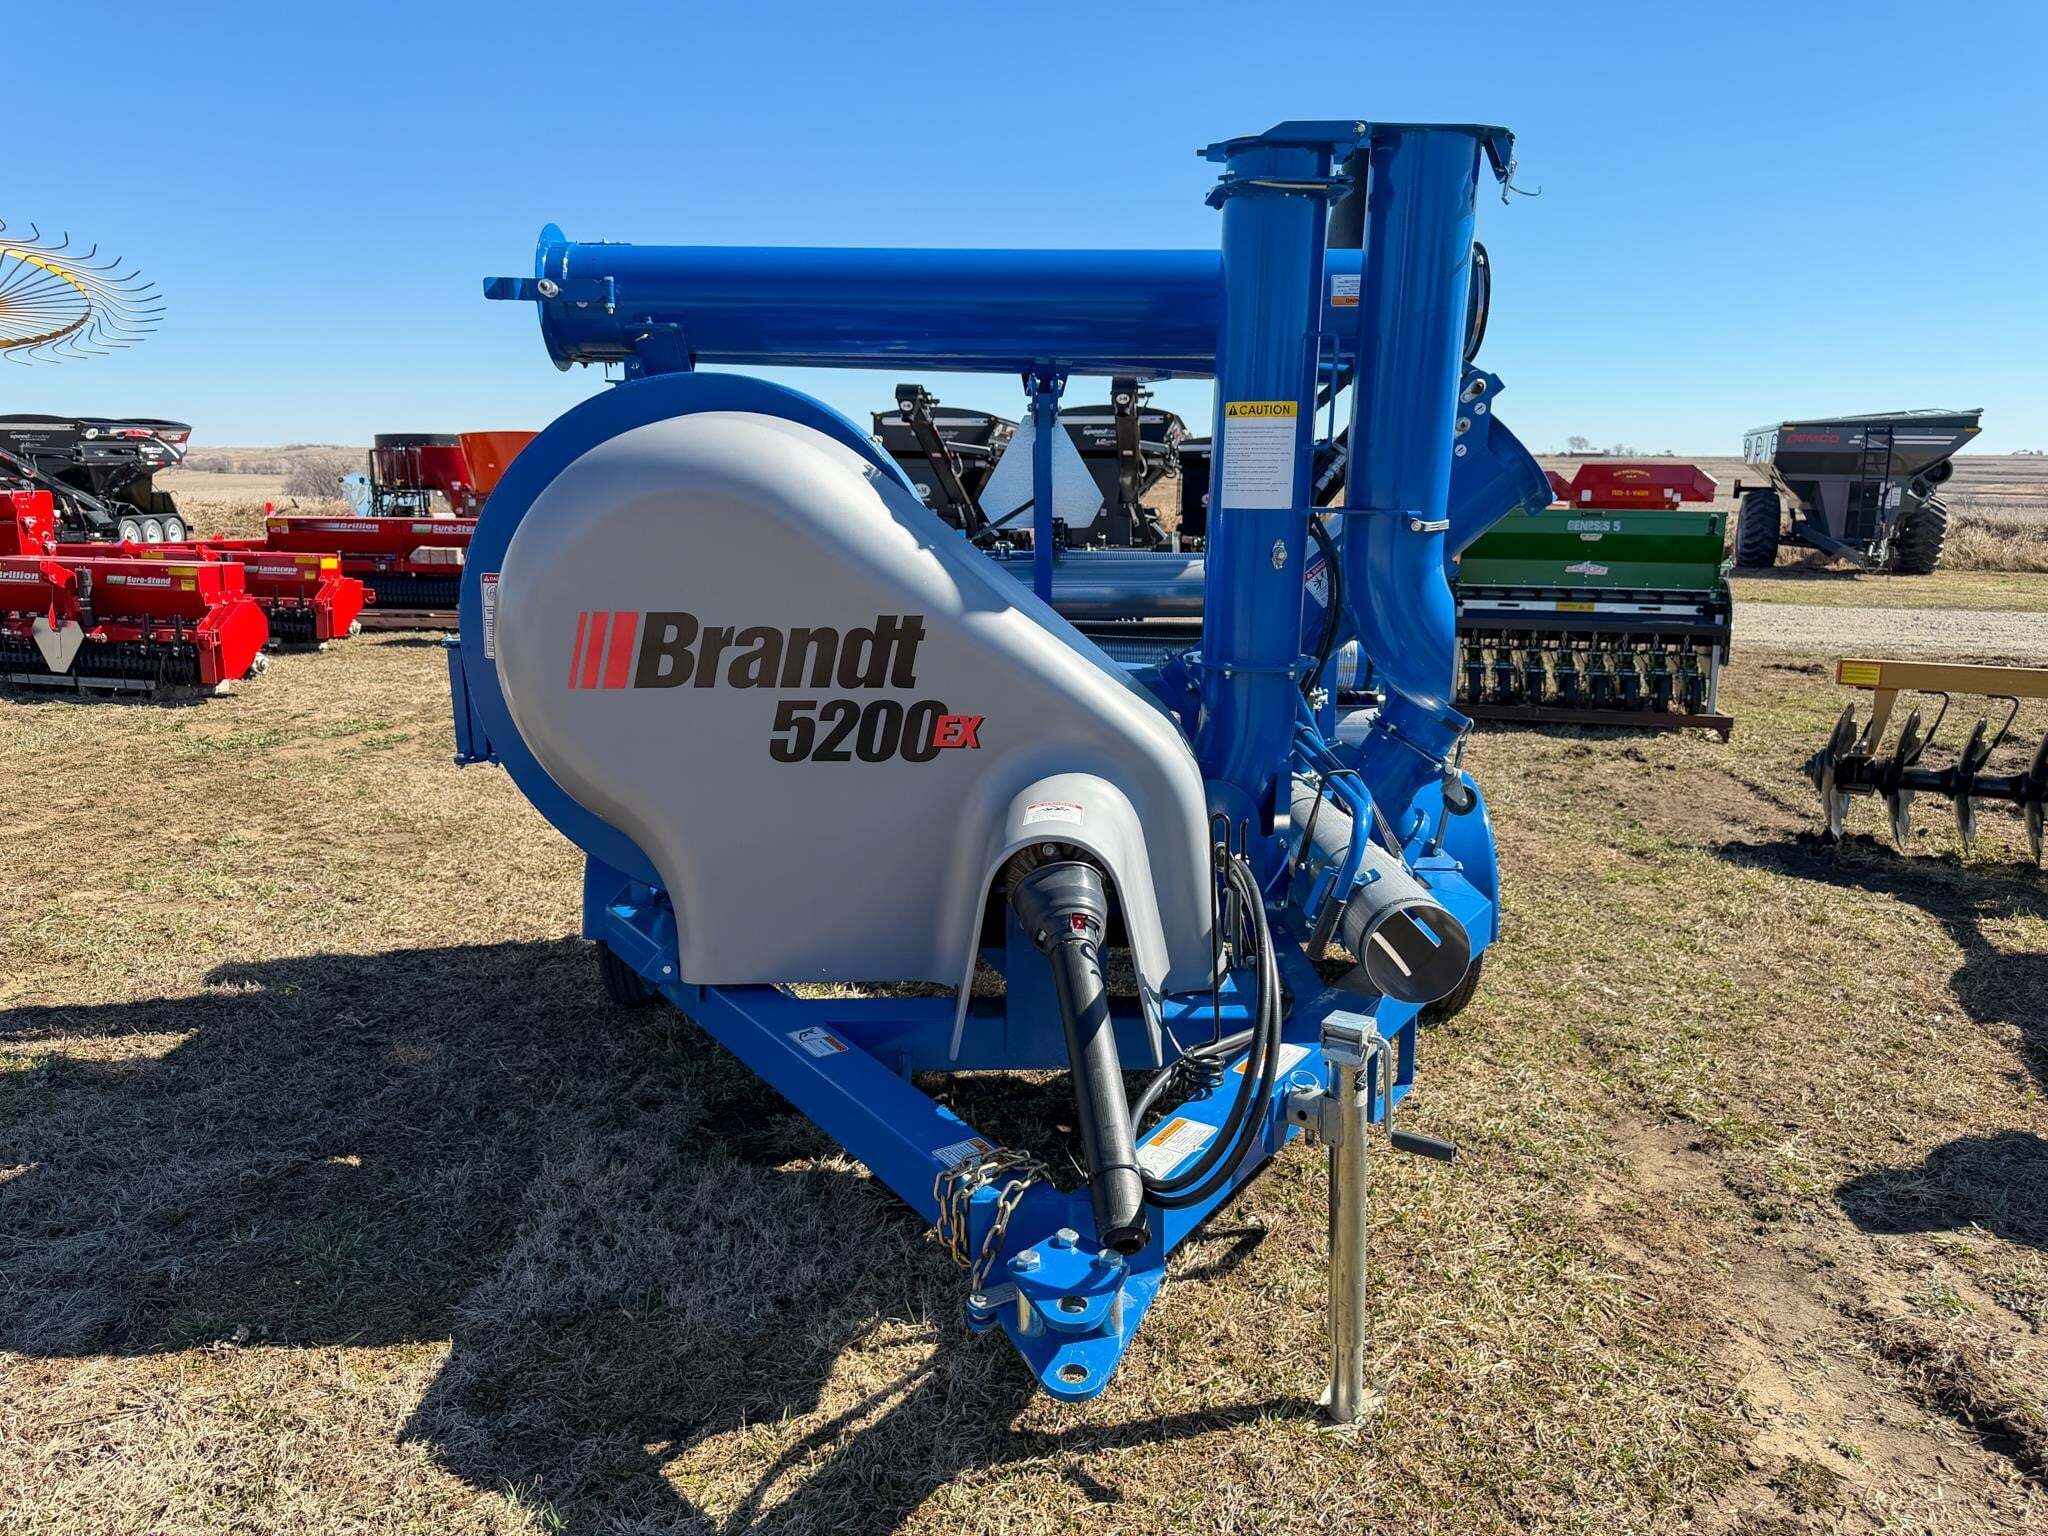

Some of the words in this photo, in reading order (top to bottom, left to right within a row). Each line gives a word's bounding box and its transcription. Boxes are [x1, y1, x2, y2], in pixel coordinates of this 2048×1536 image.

[1239, 404, 1290, 415] CAUTION
[1567, 519, 1610, 531] GENESIS
[1613, 520, 1621, 532] 5
[126, 575, 171, 585] Sure-Stand
[634, 611, 925, 689] Brandt
